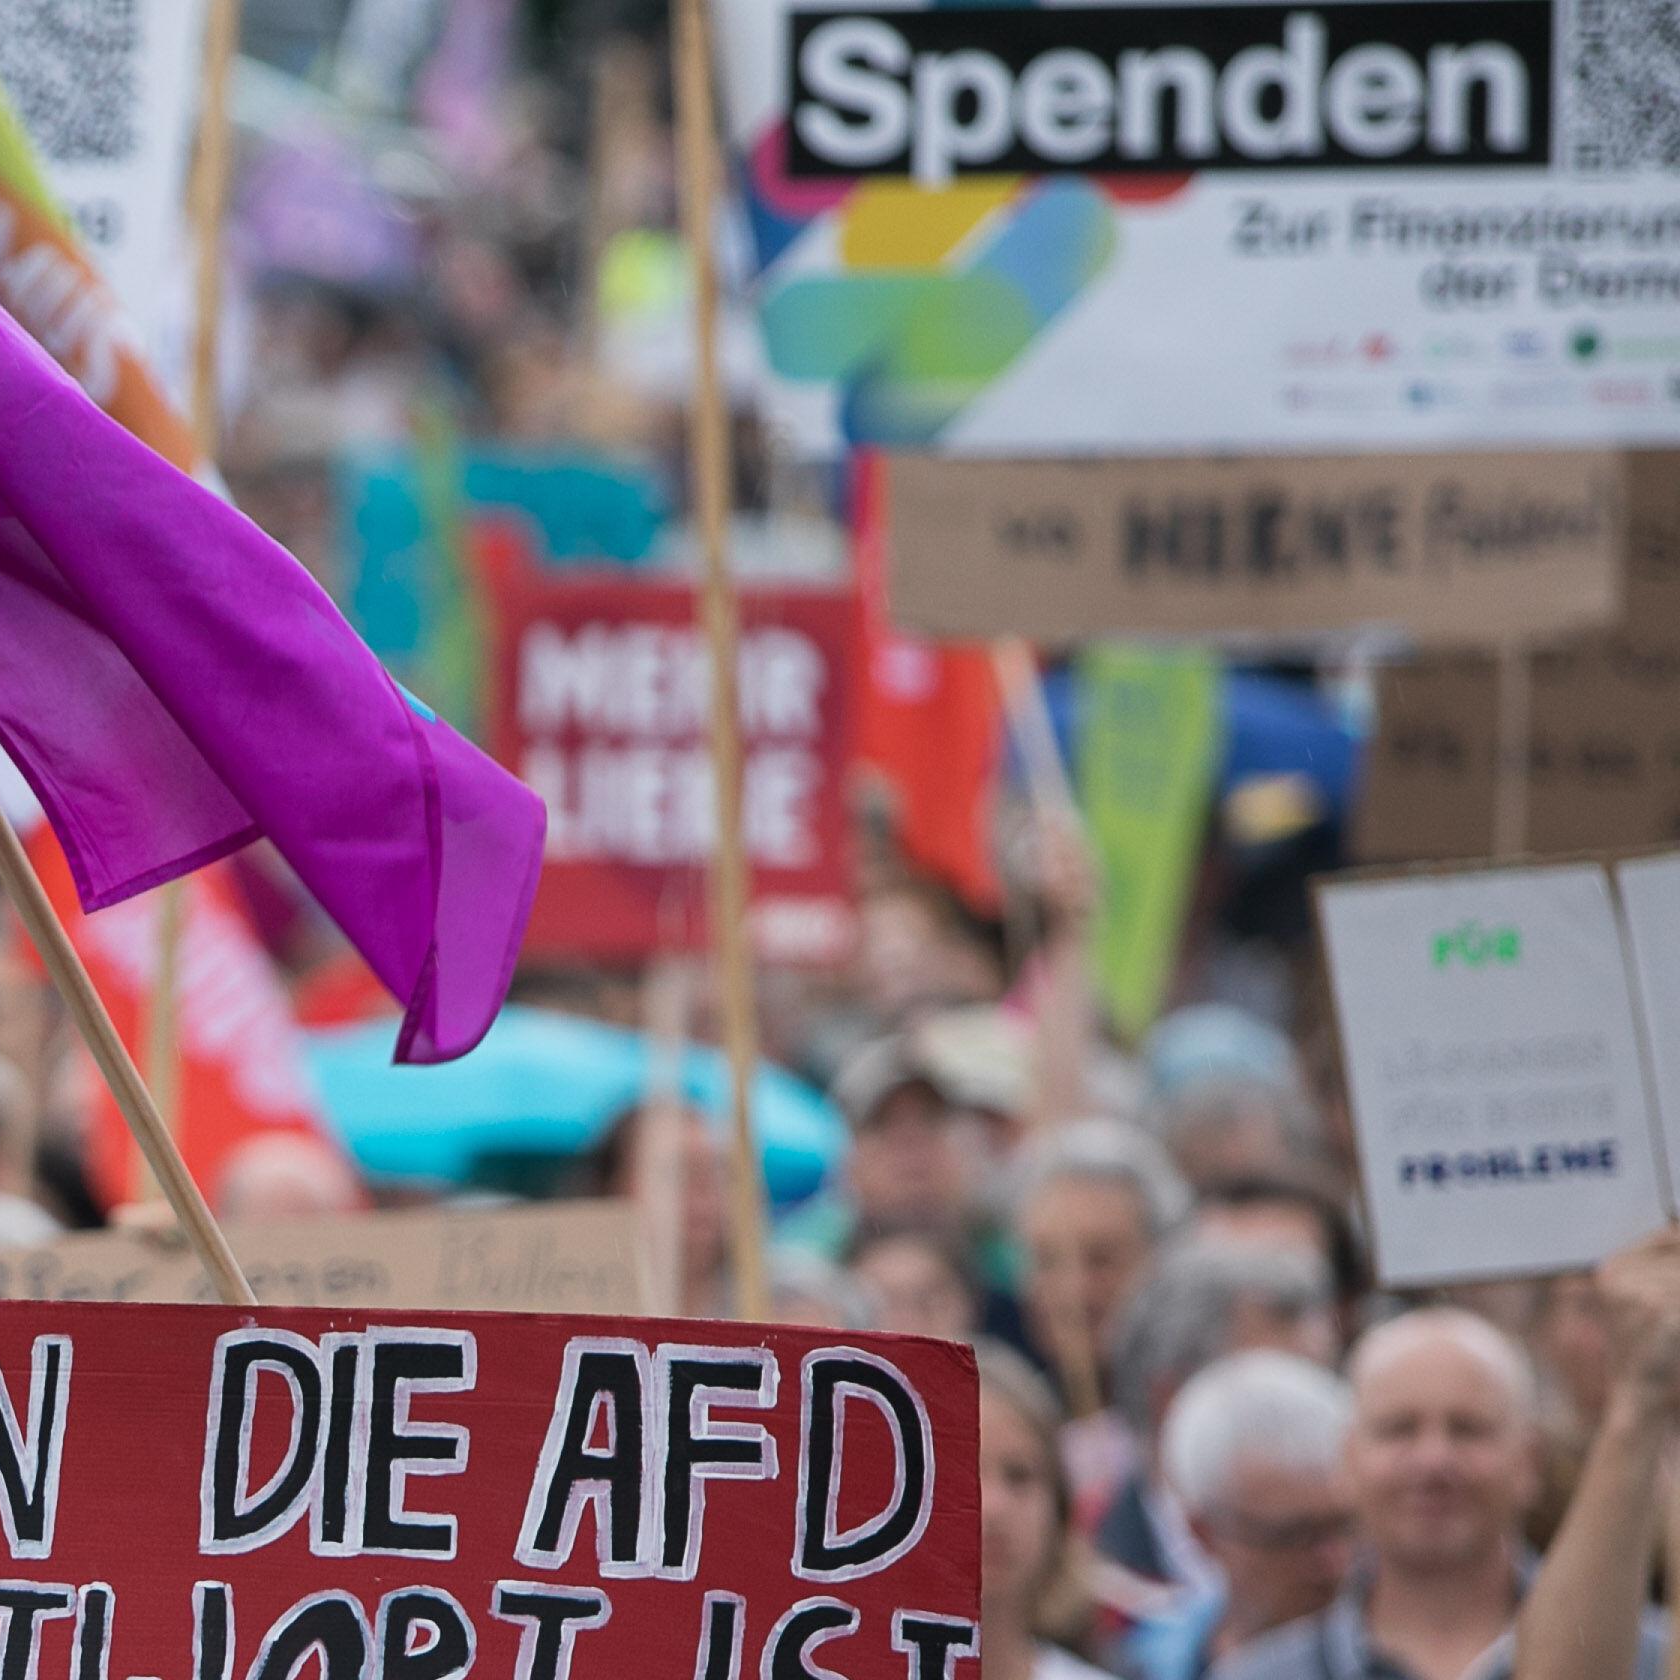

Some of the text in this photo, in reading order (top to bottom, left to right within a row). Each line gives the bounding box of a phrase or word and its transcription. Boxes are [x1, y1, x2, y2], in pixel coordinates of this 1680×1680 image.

[796, 14, 1530, 186] Spenden
[1232, 195, 1680, 258] Zur Finanzieru
[198, 1326, 478, 1561] DIE
[513, 1335, 935, 1582] AFD
